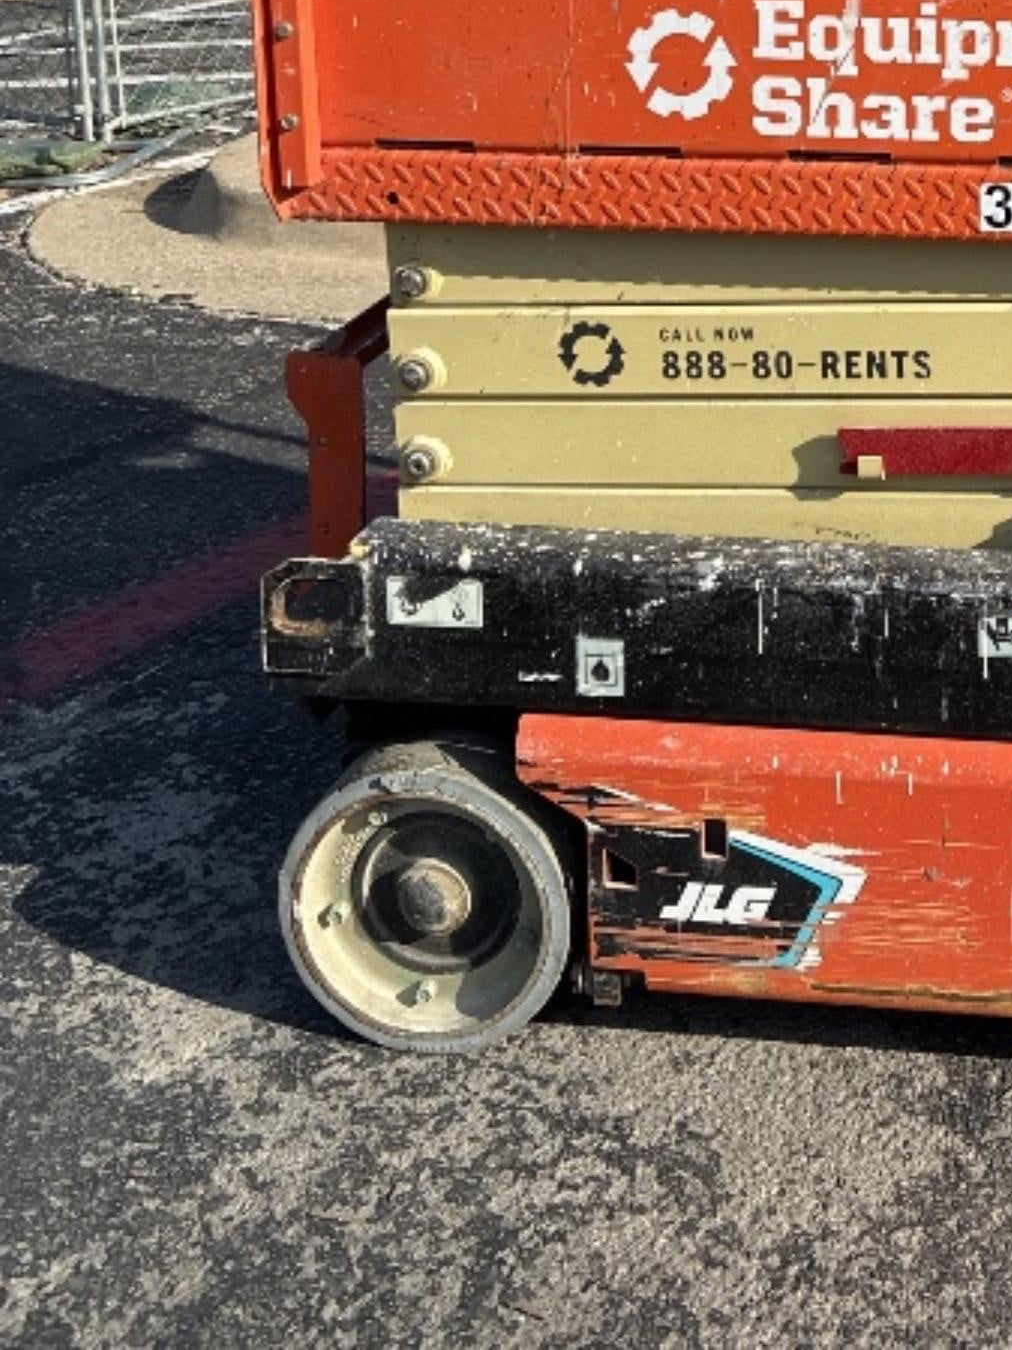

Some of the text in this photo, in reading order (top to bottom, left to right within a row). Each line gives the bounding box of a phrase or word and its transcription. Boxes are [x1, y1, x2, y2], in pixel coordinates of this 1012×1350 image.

[659, 327, 755, 343] CALL NOW
[662, 350, 932, 380] 888-80-RENTS
[659, 880, 778, 925] JLG
